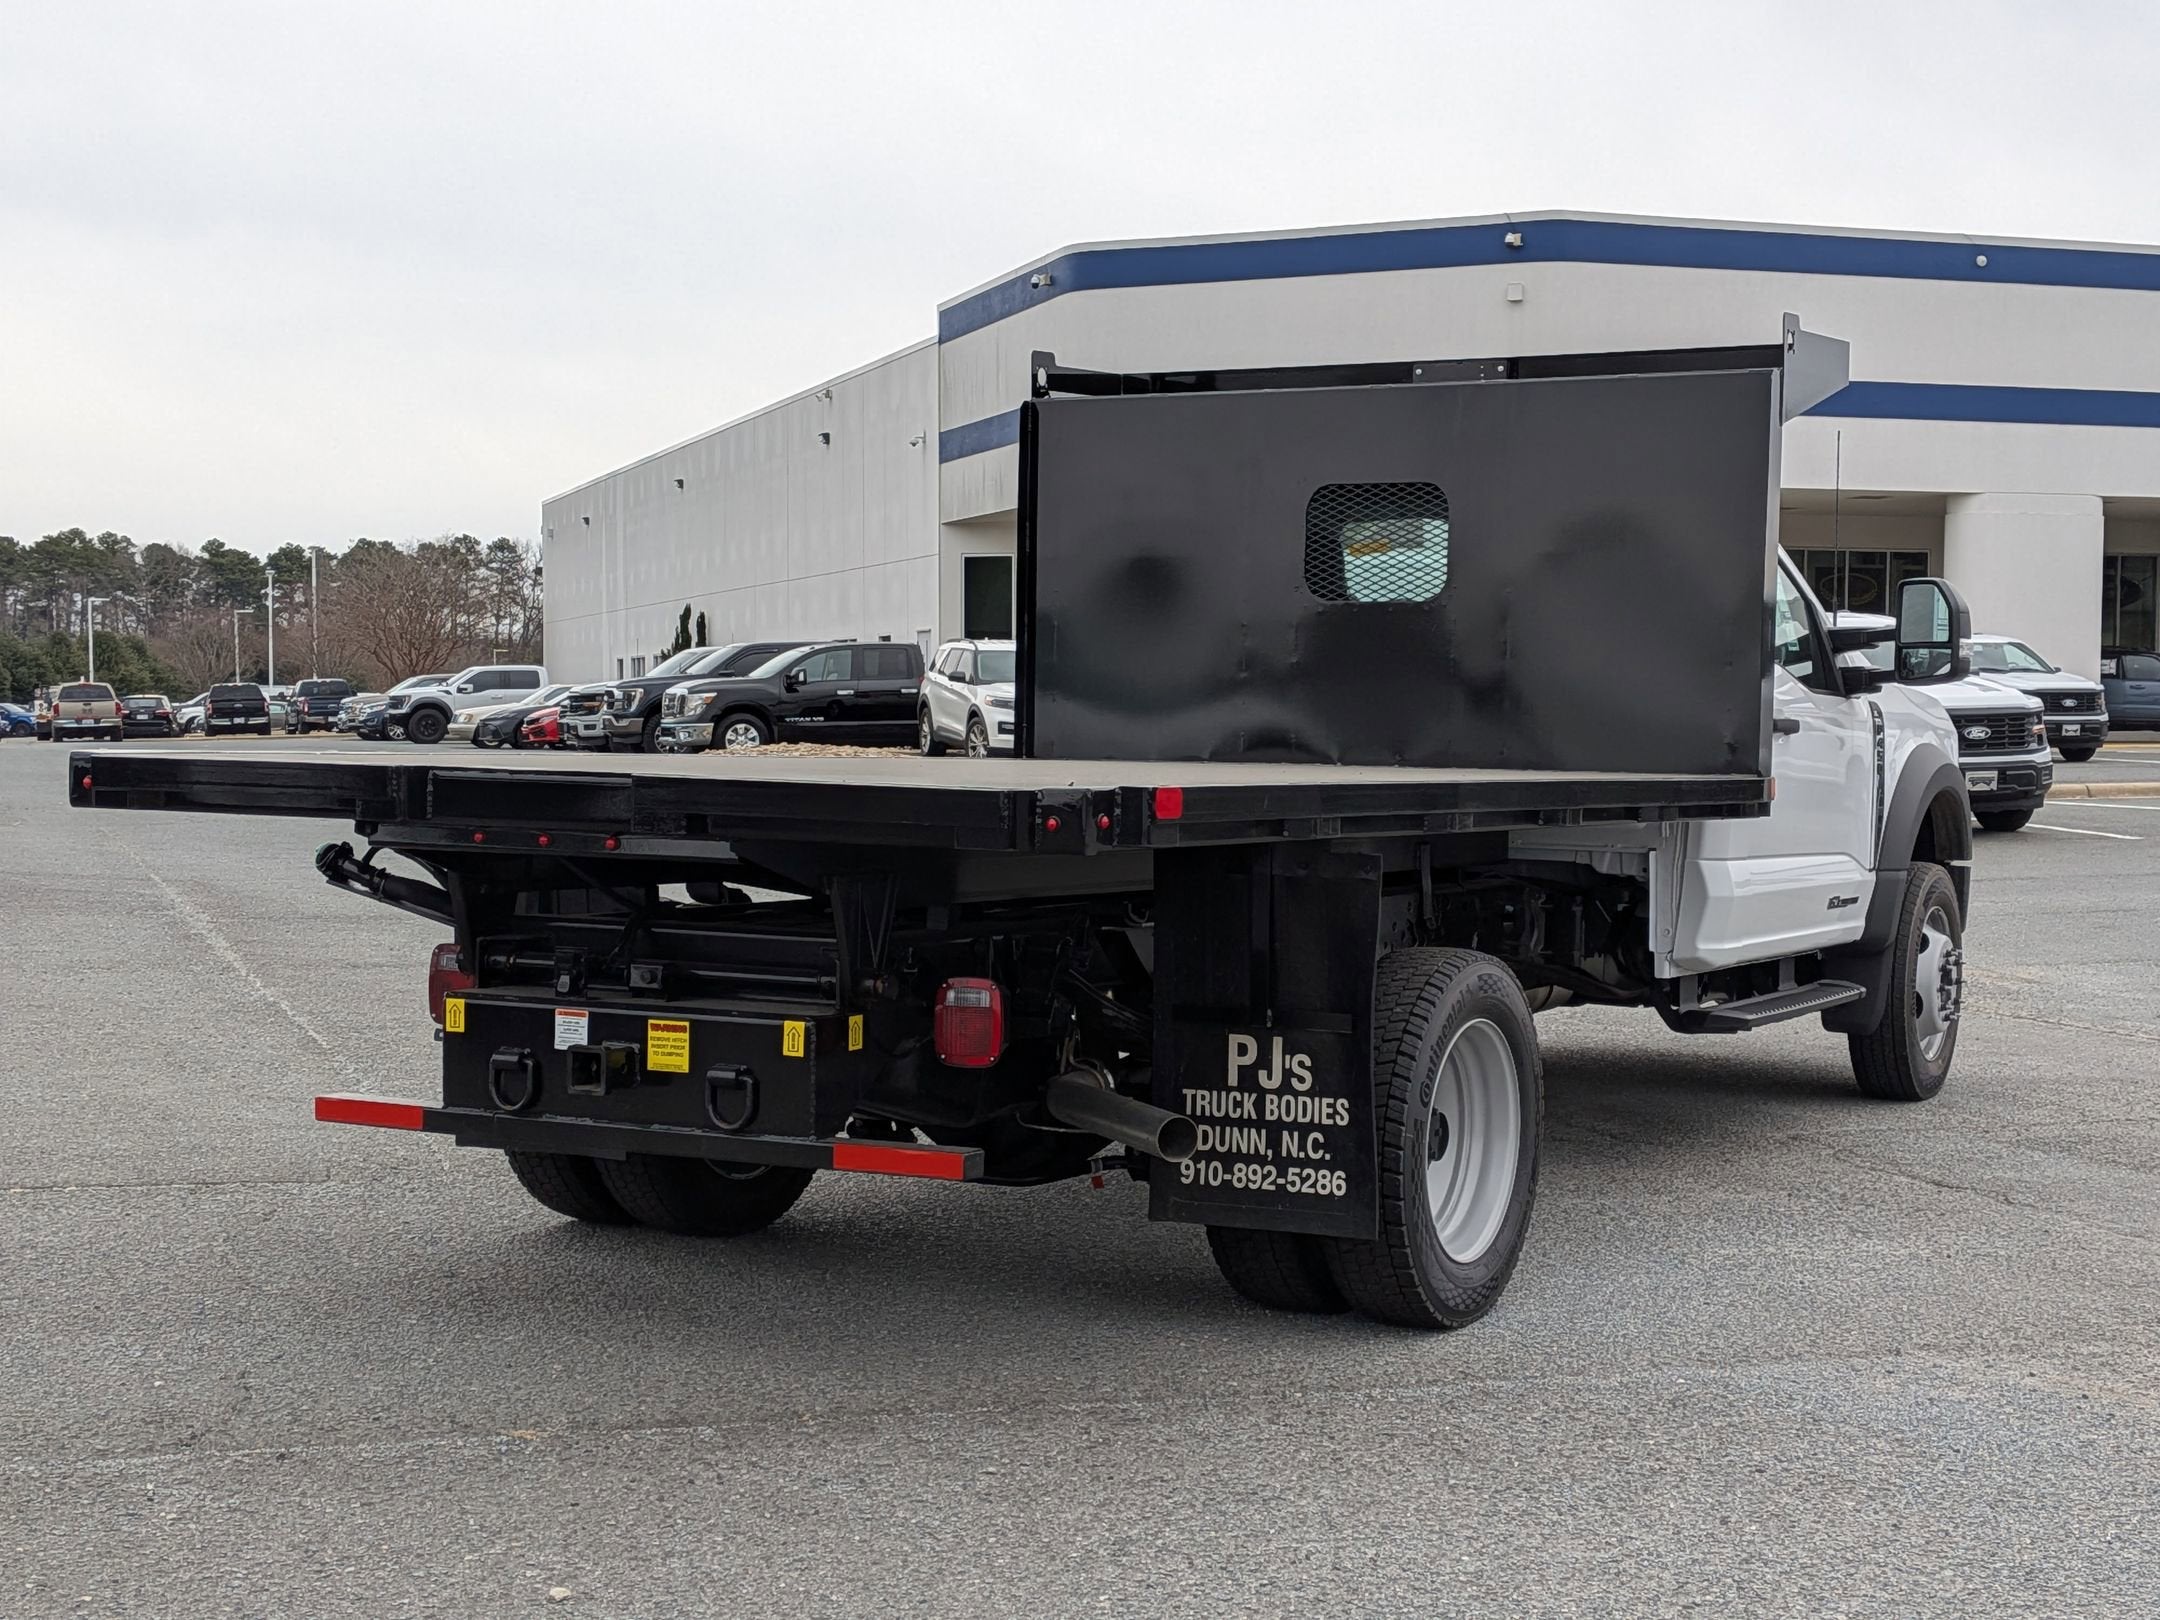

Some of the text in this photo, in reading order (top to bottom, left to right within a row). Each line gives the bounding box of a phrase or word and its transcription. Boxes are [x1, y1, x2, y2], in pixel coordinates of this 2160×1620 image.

[1182, 1088, 1350, 1126] TRUCK BODIES
[1197, 1124, 1331, 1161] DUNN, N.C.
[1180, 1159, 1347, 1196] 910-892-5286
